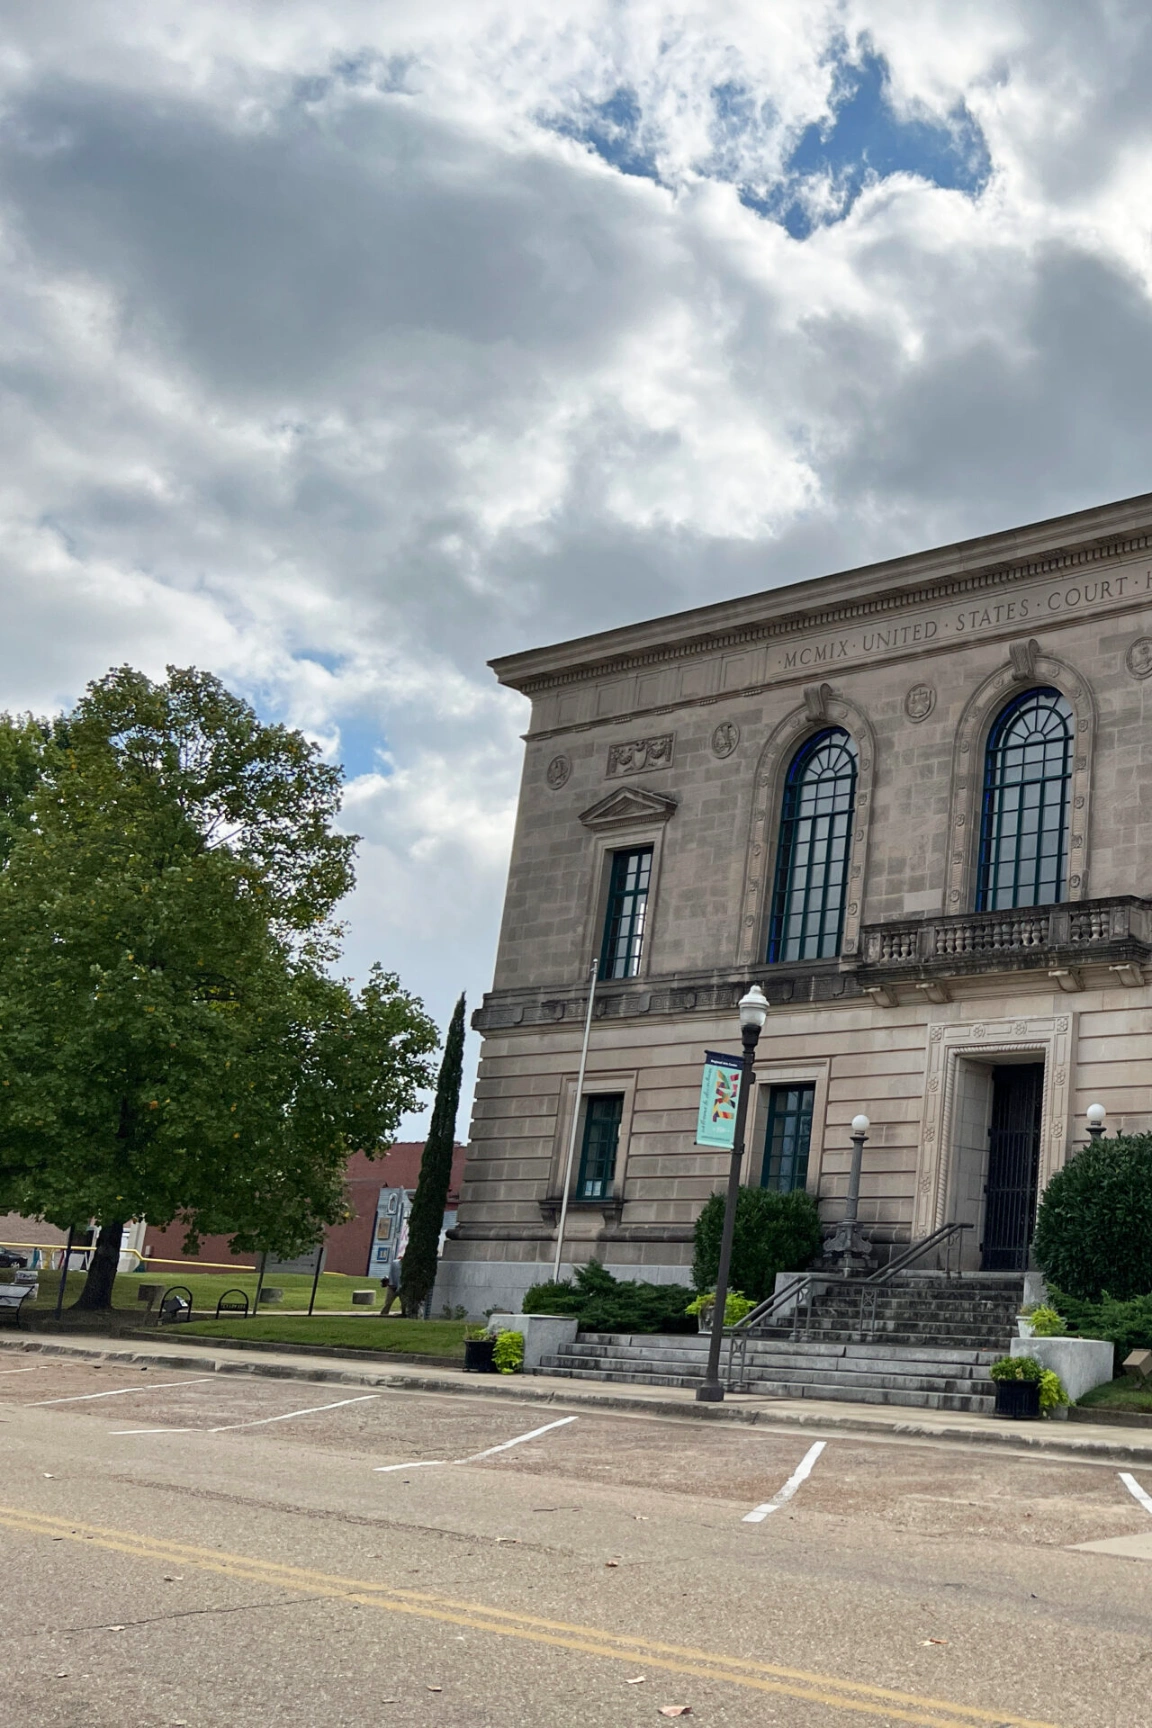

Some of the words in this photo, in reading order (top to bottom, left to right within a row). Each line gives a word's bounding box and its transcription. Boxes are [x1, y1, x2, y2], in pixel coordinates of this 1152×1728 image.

[862, 620, 938, 652] UNITED
[955, 598, 1029, 632] STATES
[1047, 576, 1129, 611] COURT
